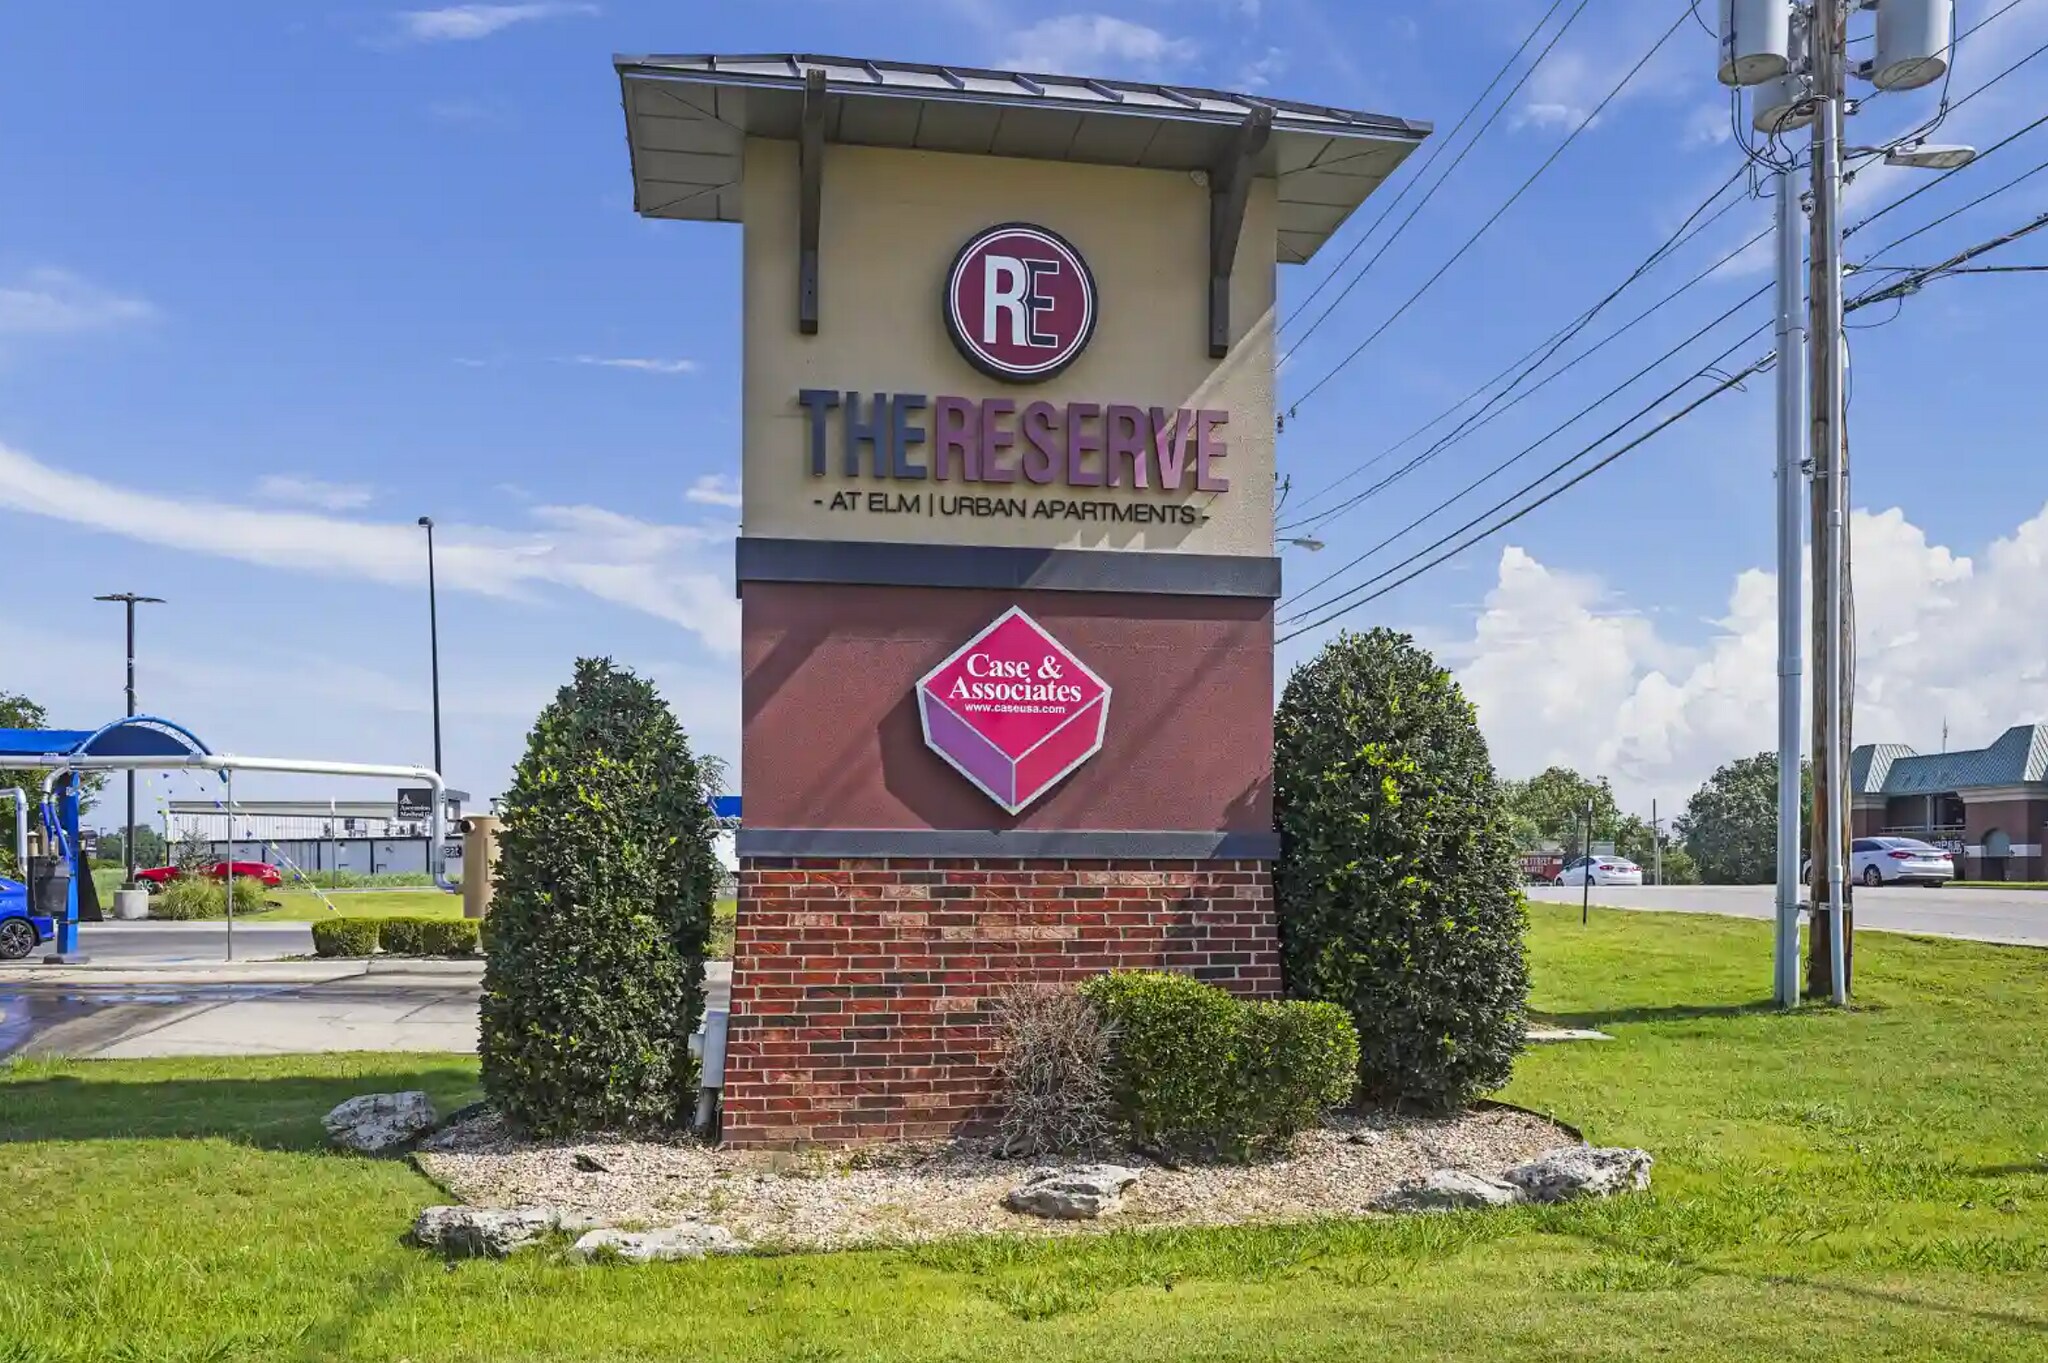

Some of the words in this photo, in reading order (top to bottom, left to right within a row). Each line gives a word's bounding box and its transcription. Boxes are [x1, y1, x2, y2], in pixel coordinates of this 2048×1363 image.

[983, 254, 1060, 349] RE
[830, 491, 862, 511] AT
[868, 492, 921, 514] ELM
[940, 496, 1027, 518] URBAN
[1033, 500, 1197, 525] APARTMENTS
[966, 653, 1030, 678] Case
[1037, 655, 1064, 680] &
[948, 675, 1082, 702] Associates
[964, 703, 1066, 714] www.caseusa.com
